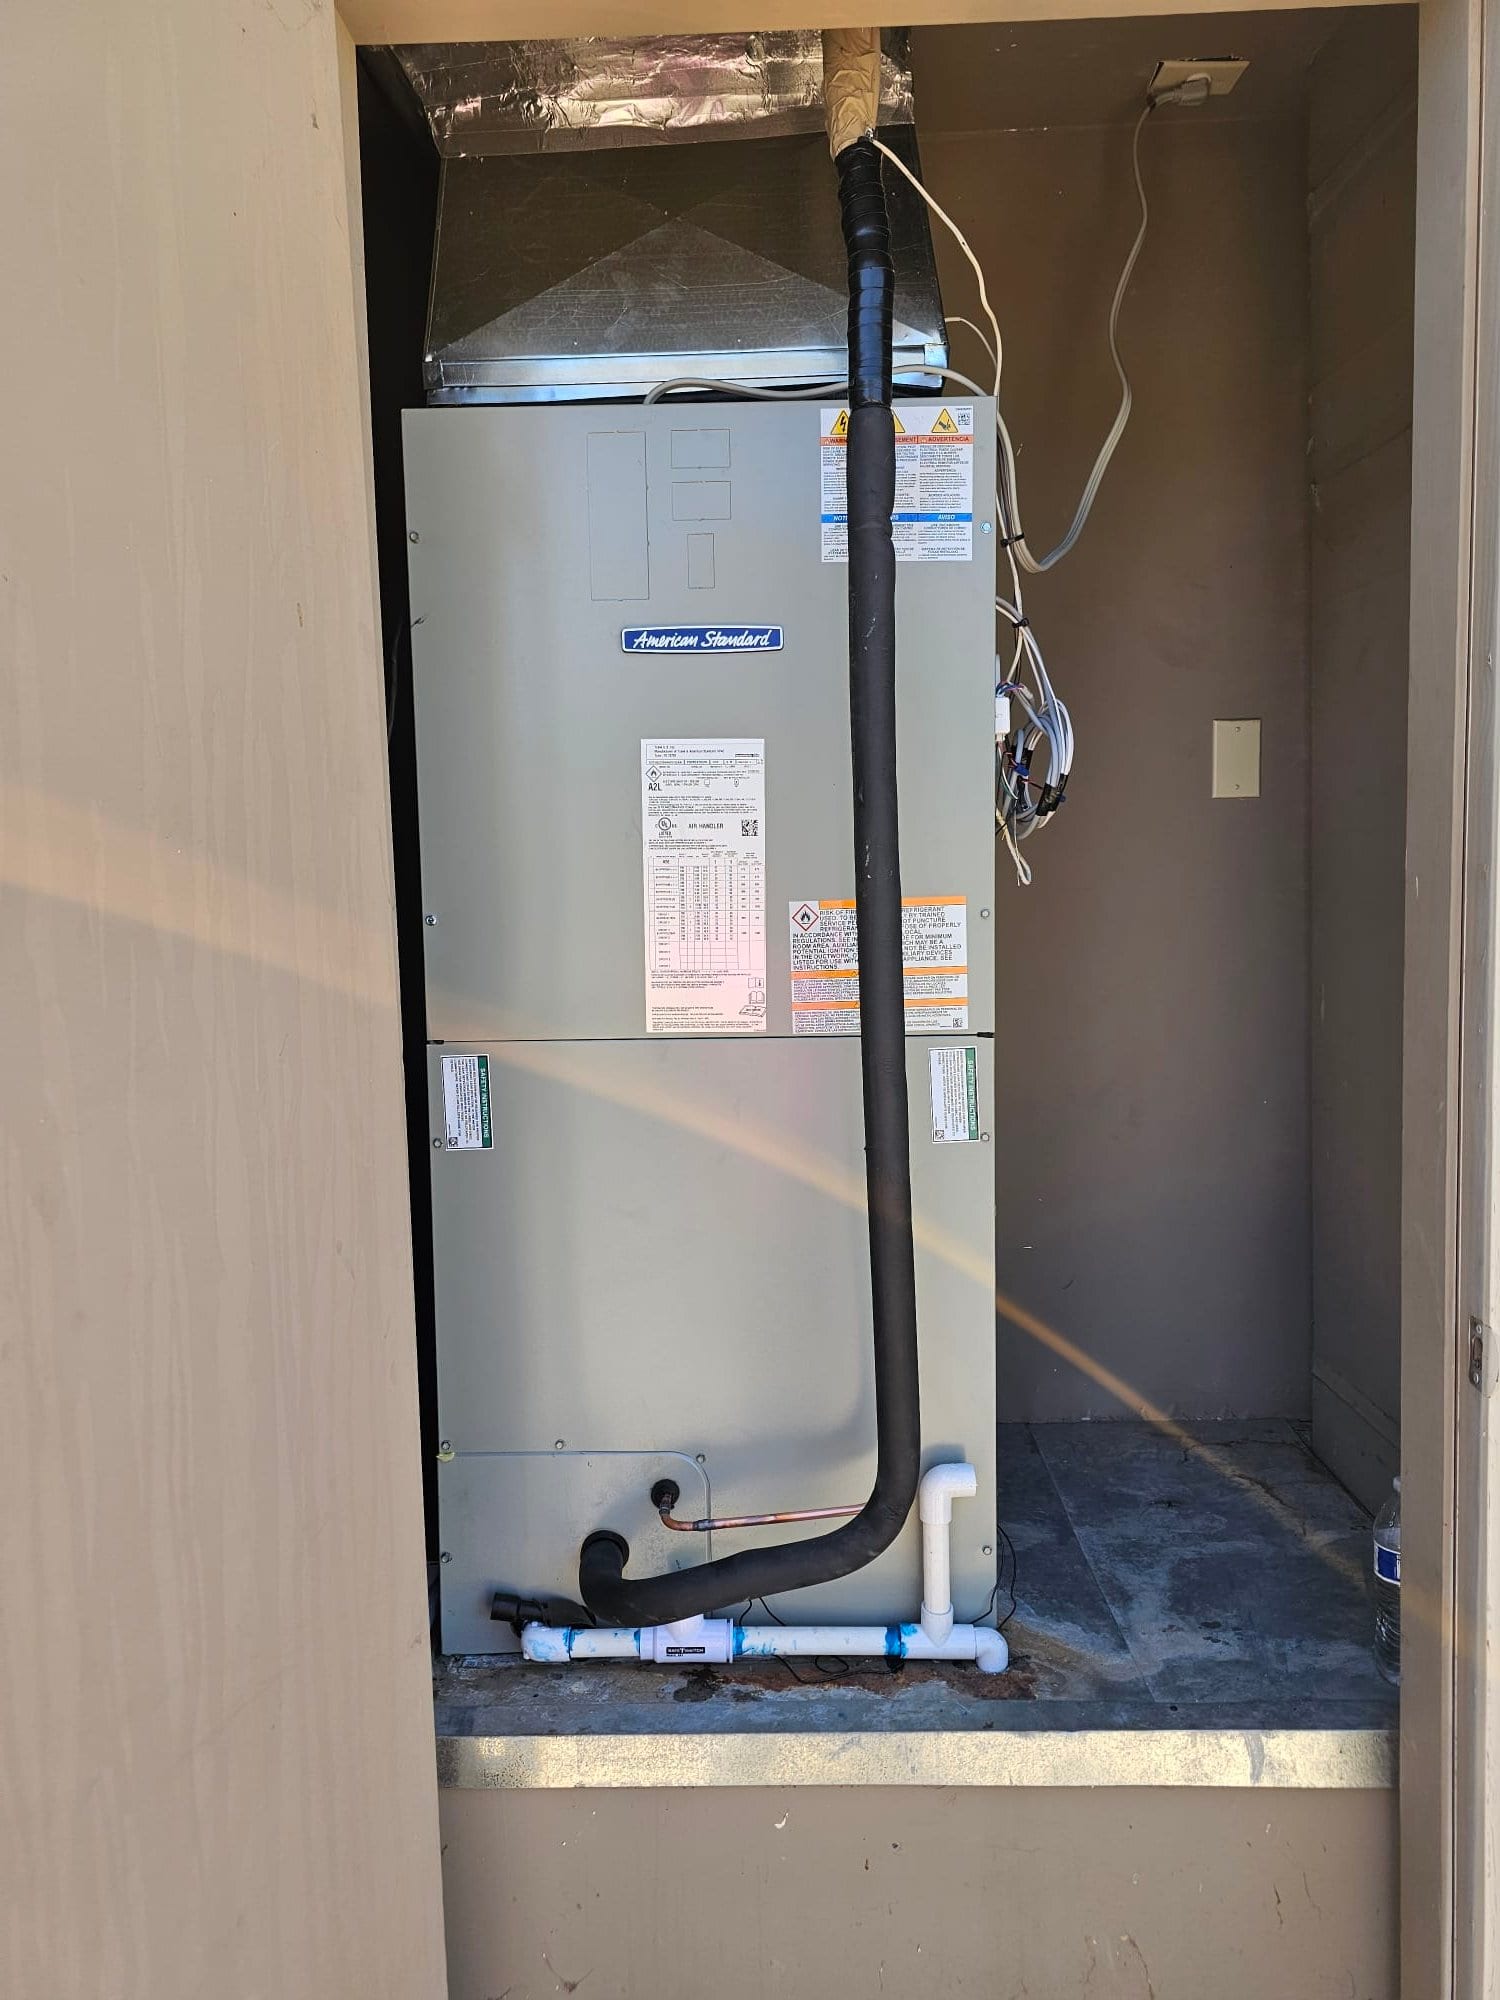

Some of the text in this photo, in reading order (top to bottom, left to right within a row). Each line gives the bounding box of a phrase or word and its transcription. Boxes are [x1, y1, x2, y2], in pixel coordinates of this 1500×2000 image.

[633, 629, 772, 649] American Standard
[648, 782, 662, 791] A2L
[481, 1092, 490, 1138] INSTRUCTIONS
[968, 1085, 976, 1131] INSTRUCTIONS
